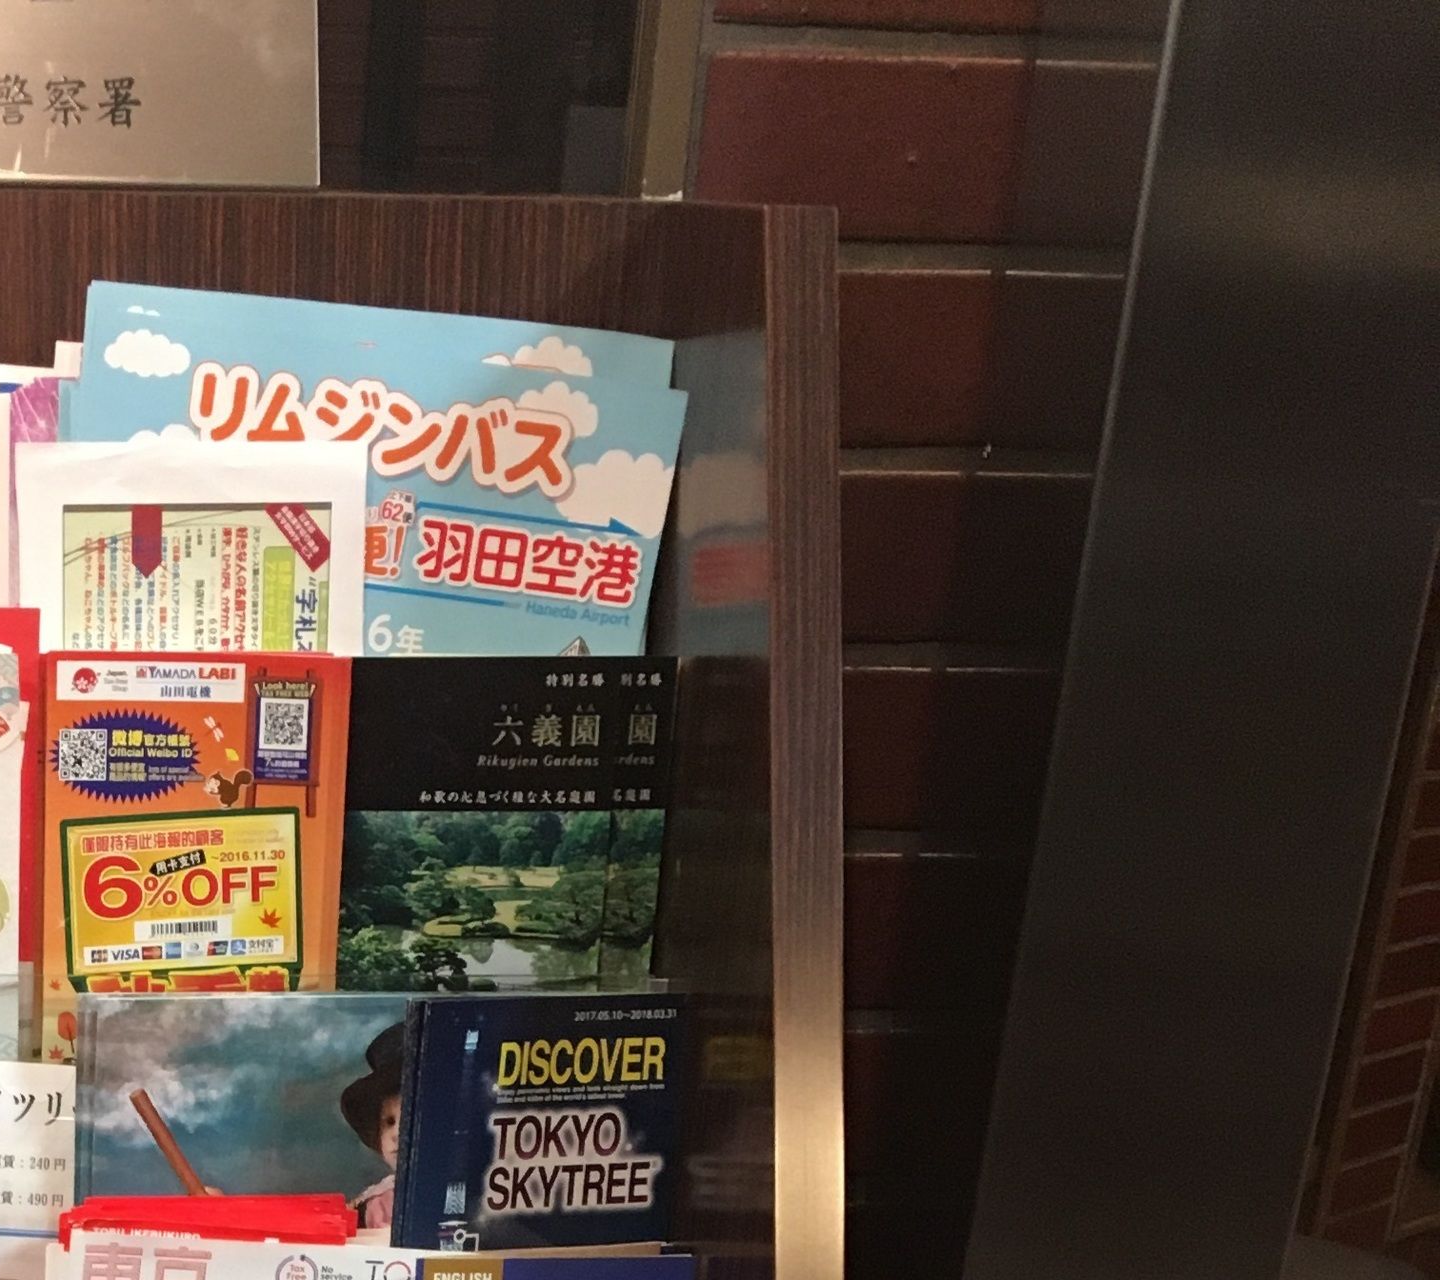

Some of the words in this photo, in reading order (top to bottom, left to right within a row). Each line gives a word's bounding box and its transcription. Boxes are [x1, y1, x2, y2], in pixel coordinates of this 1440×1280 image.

[196, 367, 568, 490] リムジンバス
[416, 519, 640, 604] 羽田空港
[526, 601, 578, 621] Haneda
[580, 605, 630, 627] Airport
[198, 667, 236, 680] LABI
[491, 714, 601, 748] 六義園
[477, 754, 538, 770] Rikugien
[111, 949, 140, 961] VISA
[497, 1036, 666, 1087] DISCOVER
[493, 1112, 621, 1160] TOKYO
[486, 1162, 651, 1211] SKYTREE
